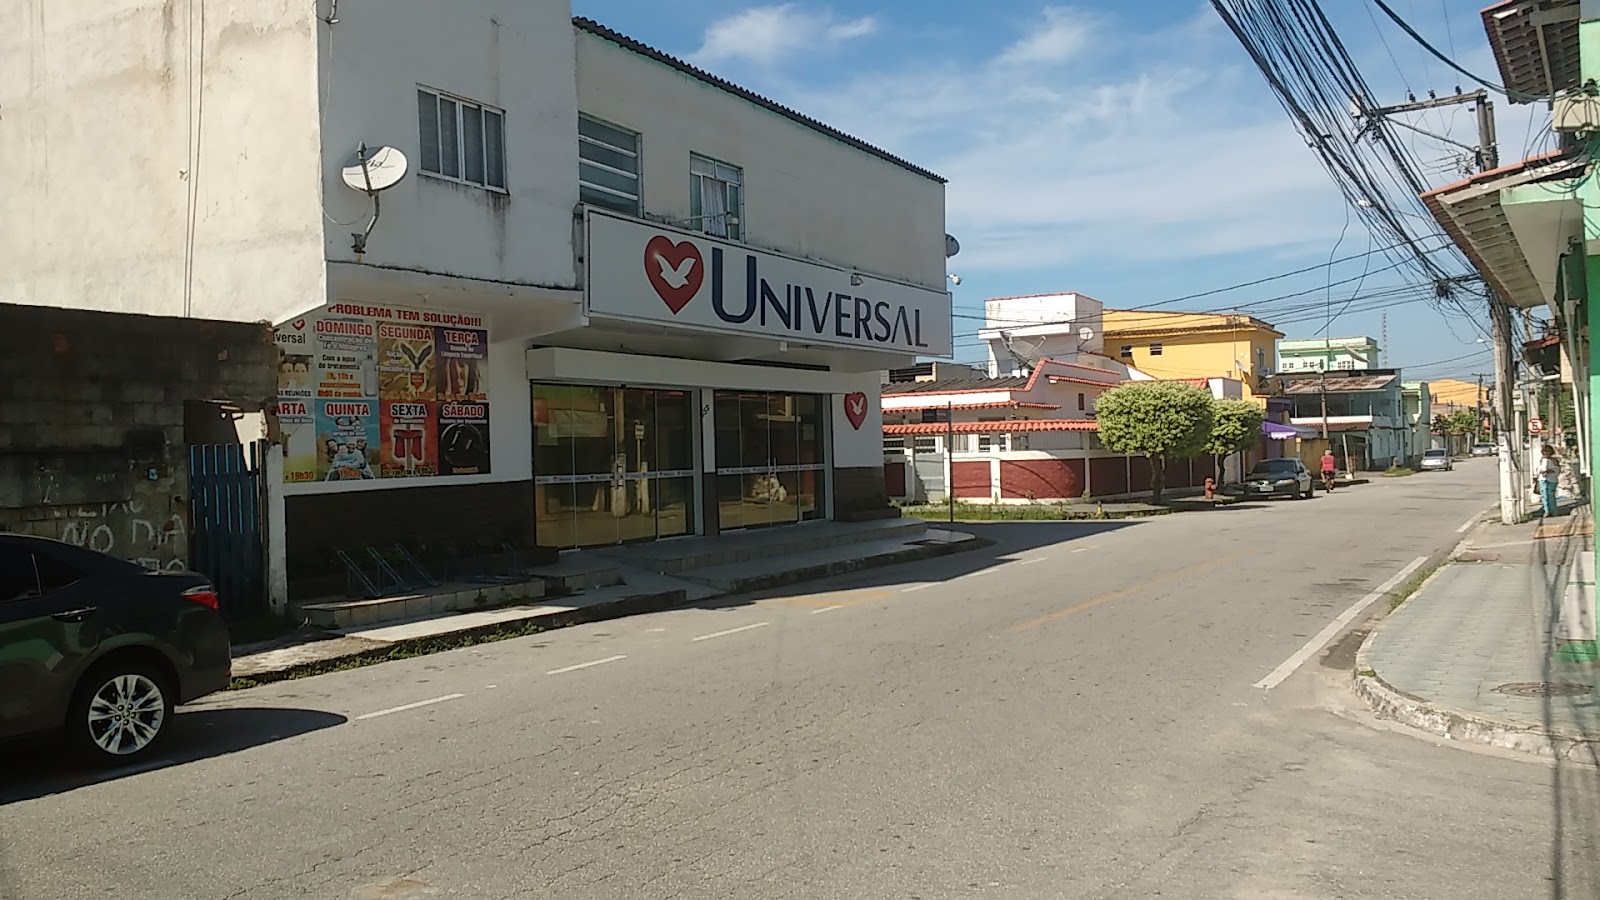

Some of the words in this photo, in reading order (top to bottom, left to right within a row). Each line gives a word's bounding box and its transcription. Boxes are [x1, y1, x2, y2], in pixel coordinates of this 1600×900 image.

[712, 247, 928, 348] UNIVERSAL
[396, 310, 419, 321] TEM
[423, 312, 481, 327] SOLUÇÃO!!!
[317, 321, 372, 336] DOMINGO
[380, 326, 431, 340] SEGUNDA
[445, 331, 478, 345] TERÇA
[326, 403, 370, 416] QUINTA
[392, 404, 426, 416] SEXTA
[444, 402, 483, 416] SÁBADO
